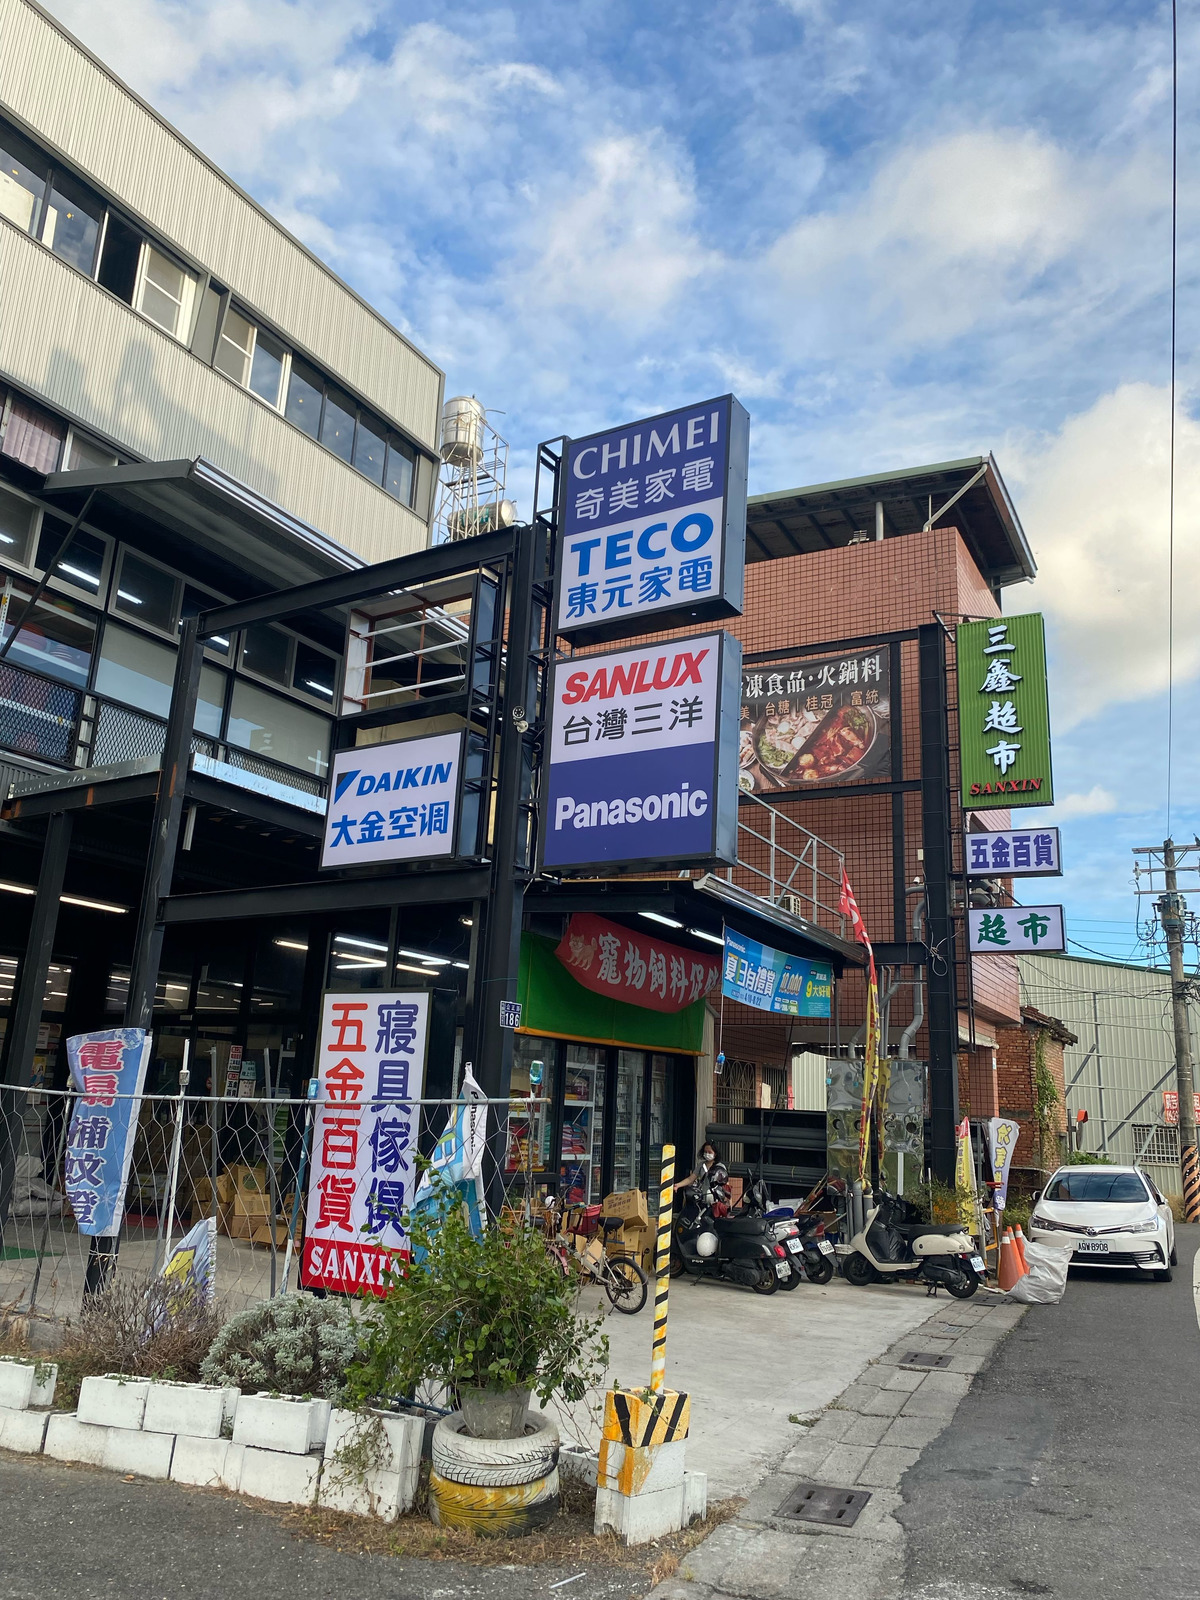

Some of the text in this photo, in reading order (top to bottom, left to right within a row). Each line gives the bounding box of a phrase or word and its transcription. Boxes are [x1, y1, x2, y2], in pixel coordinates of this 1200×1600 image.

[572, 411, 719, 480] CHIMEI
[574, 456, 715, 520] 奇美家電
[570, 512, 714, 577] TECO
[565, 555, 713, 619] 東元家電
[561, 648, 710, 706] SANLUX
[978, 624, 1024, 775] 三鑫超市
[562, 695, 703, 746] 台灣三洋
[765, 699, 790, 717] 台糖
[806, 693, 834, 712] 桂冠
[356, 761, 453, 797] DAIKIN
[969, 778, 1043, 796] SANXIN
[330, 800, 450, 848] 大金空调
[554, 782, 708, 831] Panasonic
[970, 833, 1054, 869] 五金百貨
[977, 912, 1051, 946] 超市
[505, 1012, 520, 1027] 186
[315, 1003, 368, 1233] 五金百貨
